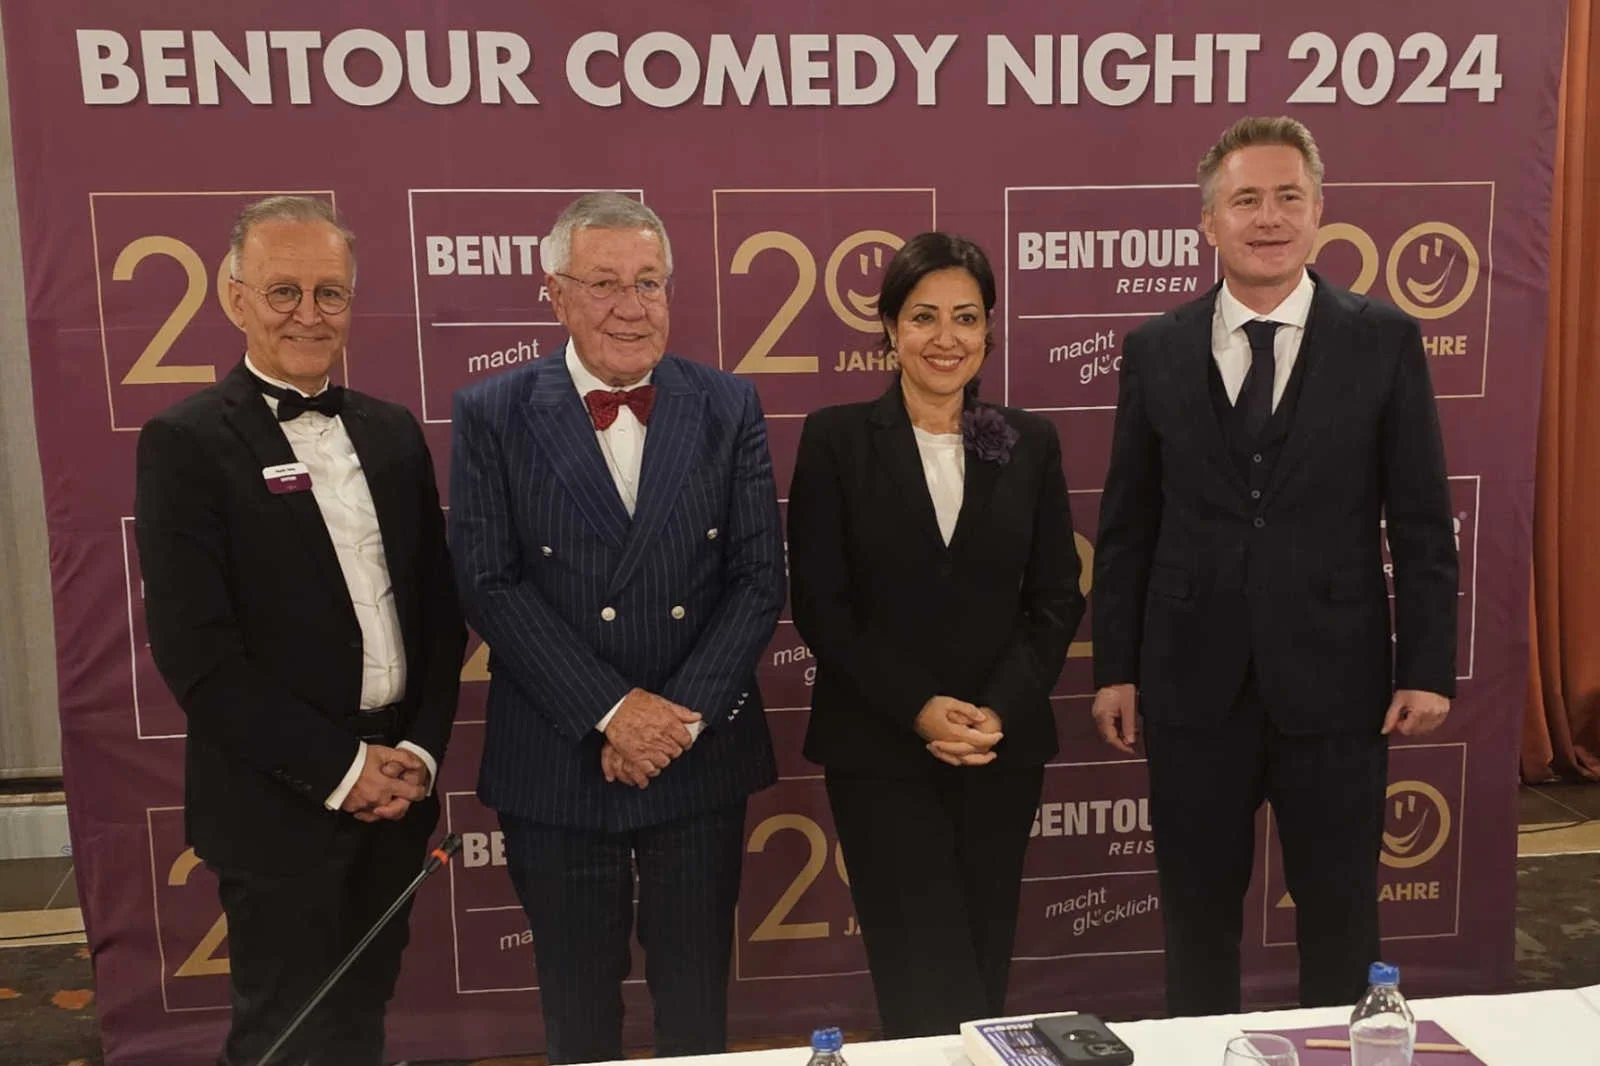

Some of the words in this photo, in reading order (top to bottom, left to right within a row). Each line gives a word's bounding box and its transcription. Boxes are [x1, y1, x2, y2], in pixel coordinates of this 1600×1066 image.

[76, 28, 539, 106] BENTOUR
[565, 31, 959, 107] COMEDY
[986, 31, 1261, 106] NIGHT
[1285, 31, 1503, 106] 2024
[1018, 229, 1200, 270] BENTOUR
[1116, 277, 1198, 294] REISEN
[112, 235, 247, 384] 2
[468, 339, 540, 373] macht
[1050, 330, 1115, 363] macht
[1046, 887, 1107, 918] macht
